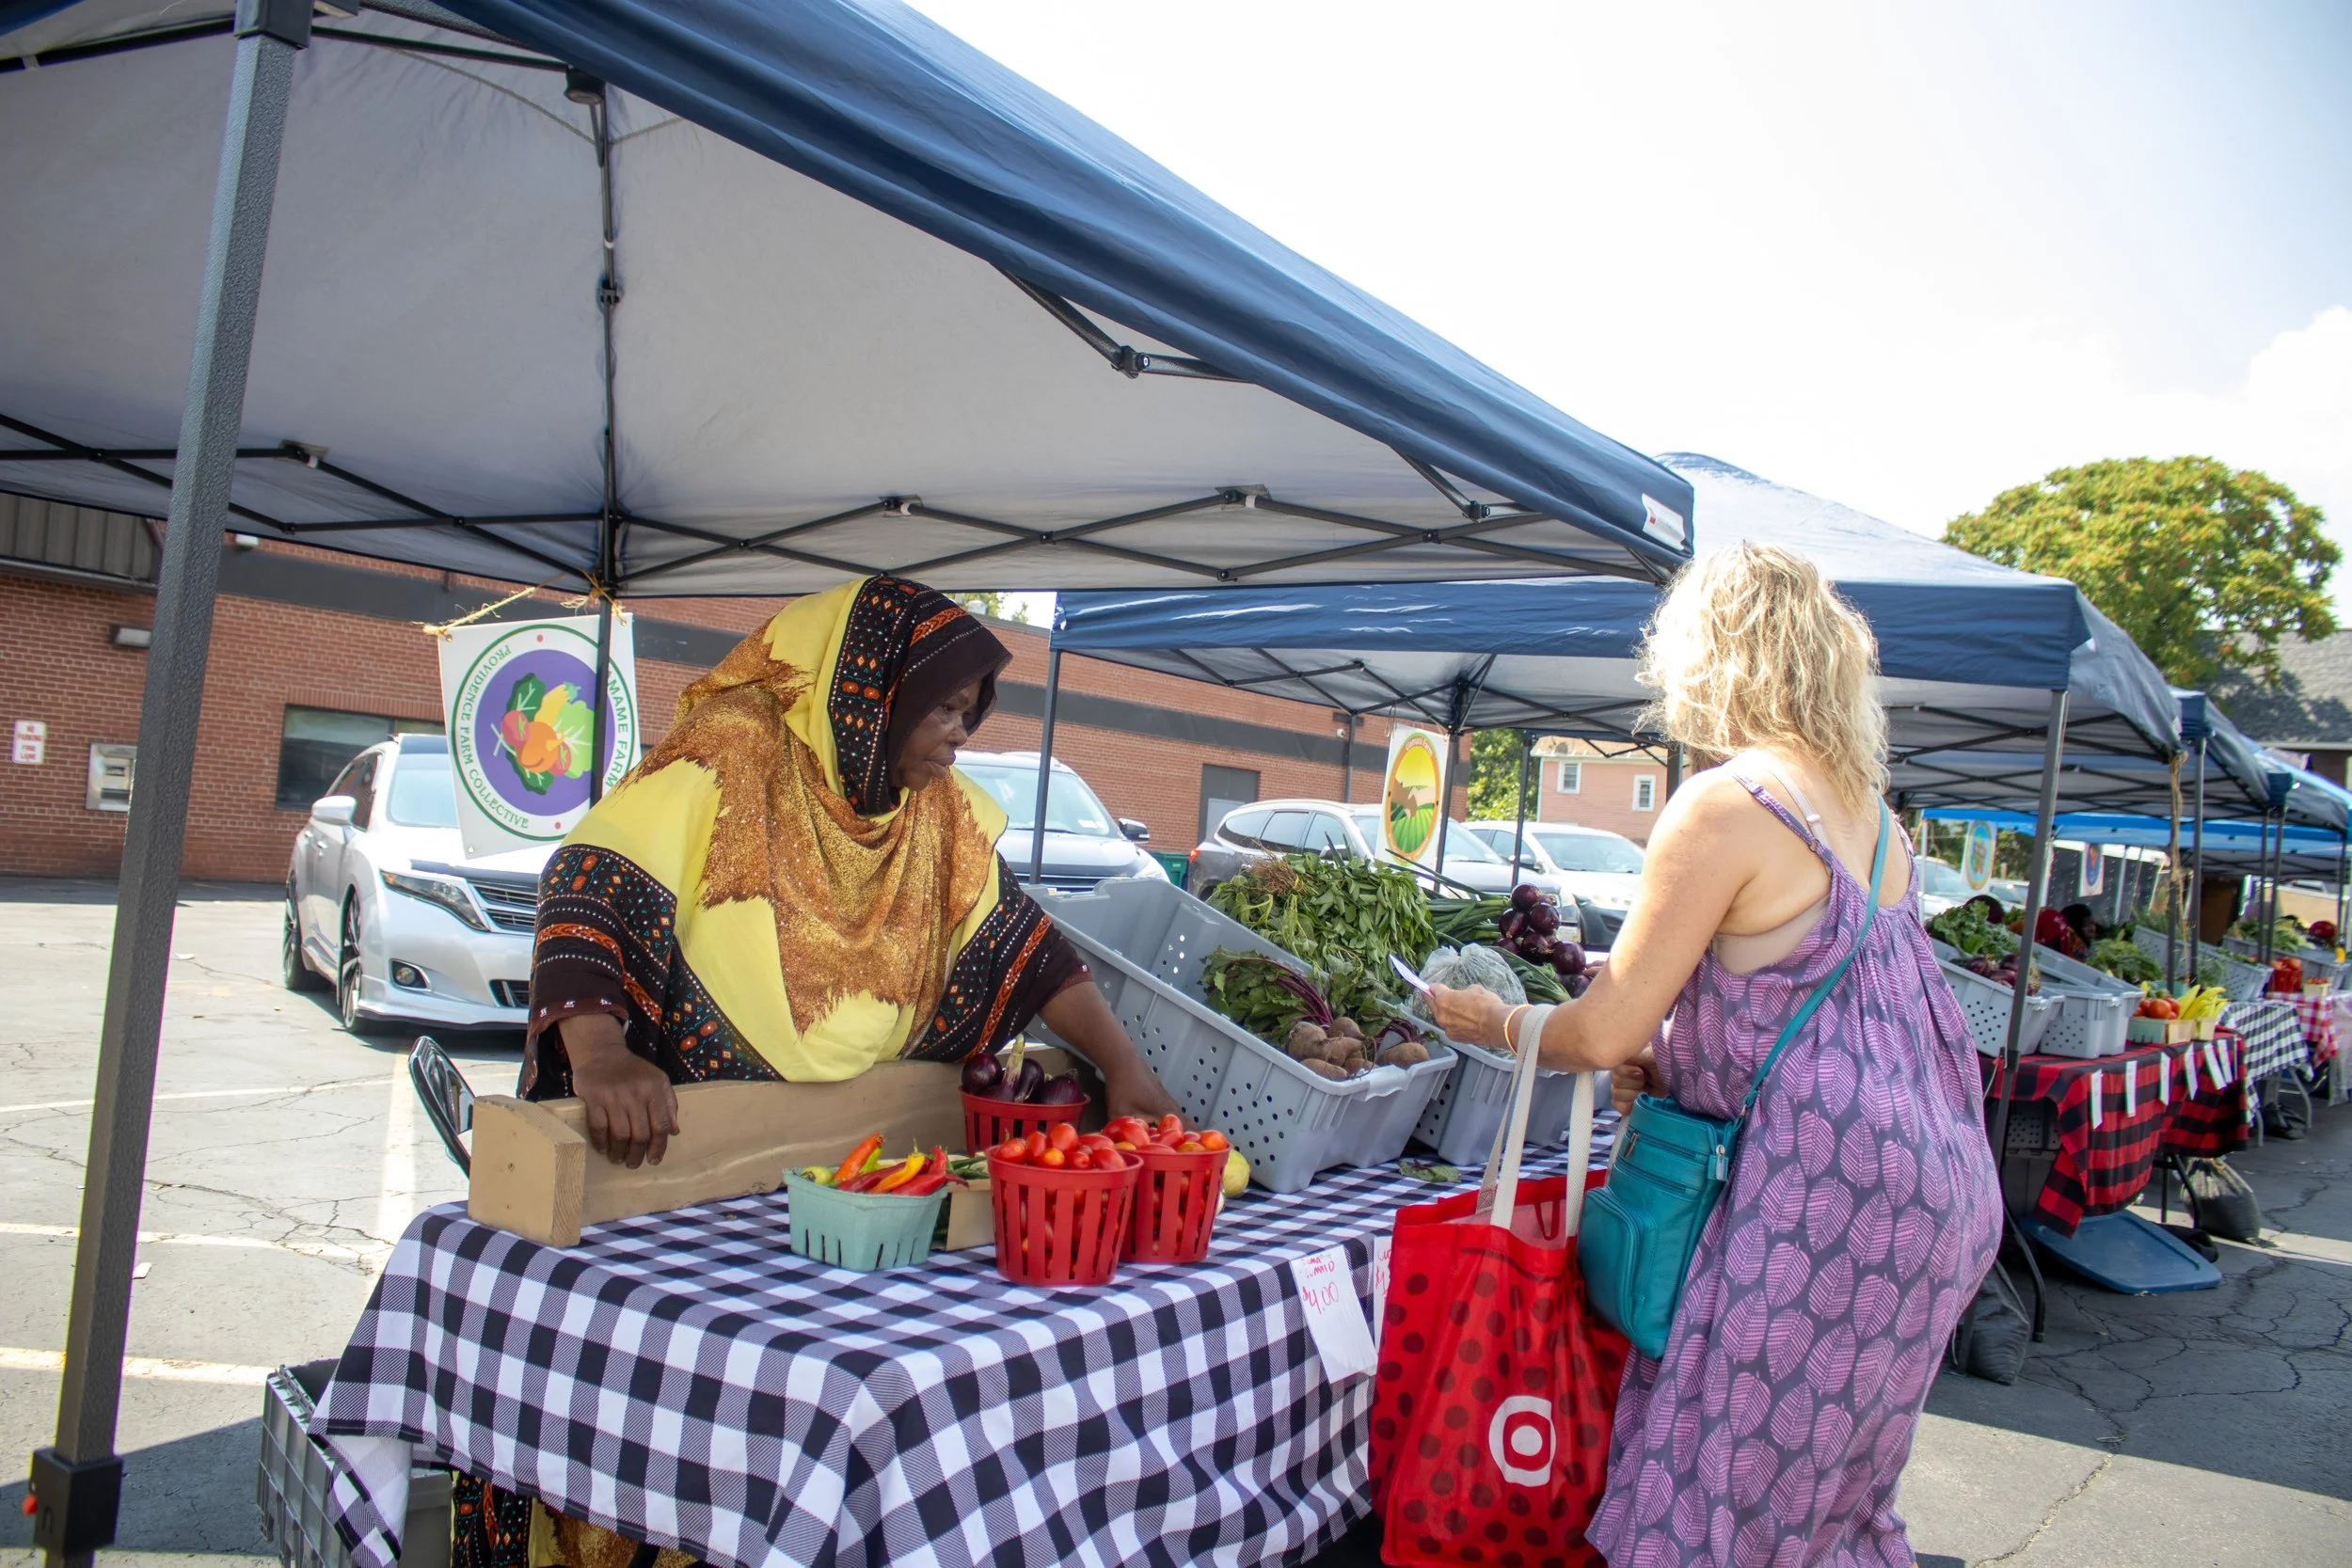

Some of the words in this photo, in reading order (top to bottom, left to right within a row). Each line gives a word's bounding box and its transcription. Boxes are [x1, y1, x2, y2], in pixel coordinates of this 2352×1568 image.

[460, 644, 512, 721] PROVIDENCE
[459, 725, 474, 766] FARM
[605, 740, 628, 788] FARM
[469, 768, 530, 829] COLLECTIVE
[1302, 1281, 1340, 1315] $4.00
